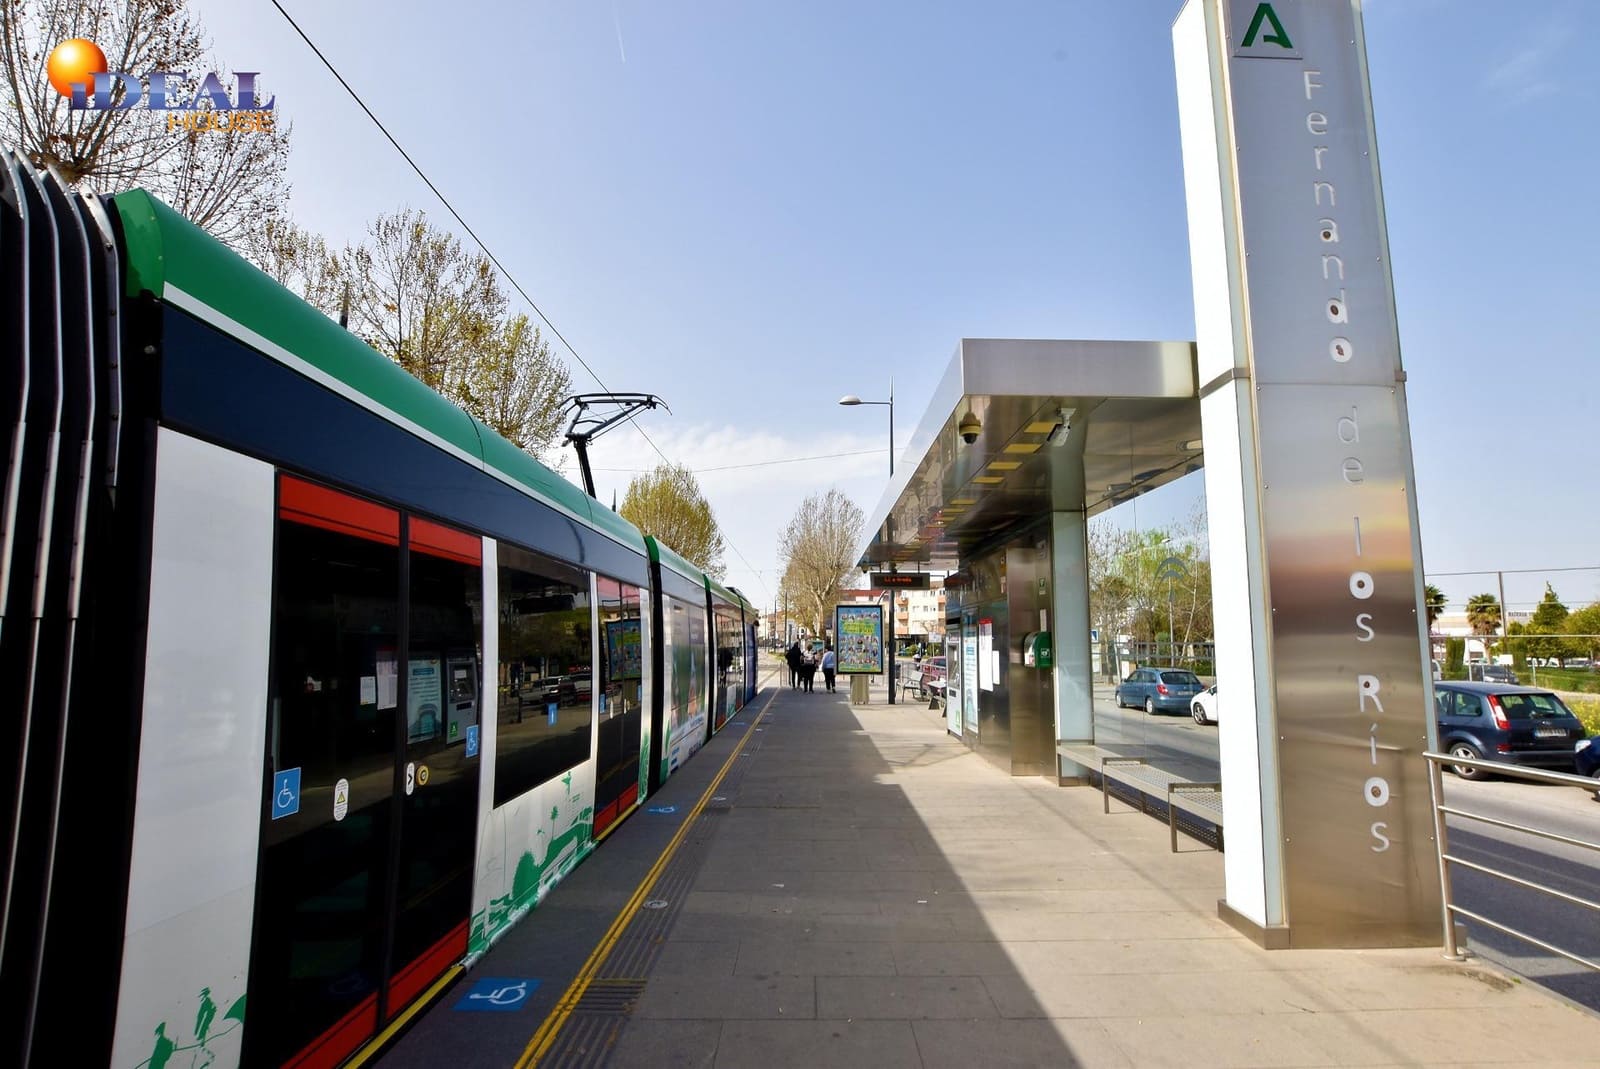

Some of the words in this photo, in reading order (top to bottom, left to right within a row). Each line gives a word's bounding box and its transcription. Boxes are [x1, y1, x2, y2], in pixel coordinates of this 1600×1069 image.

[1302, 70, 1353, 363] Fernando
[1336, 405, 1364, 485] de
[1348, 516, 1375, 643] los
[1357, 673, 1390, 853] Ríos
